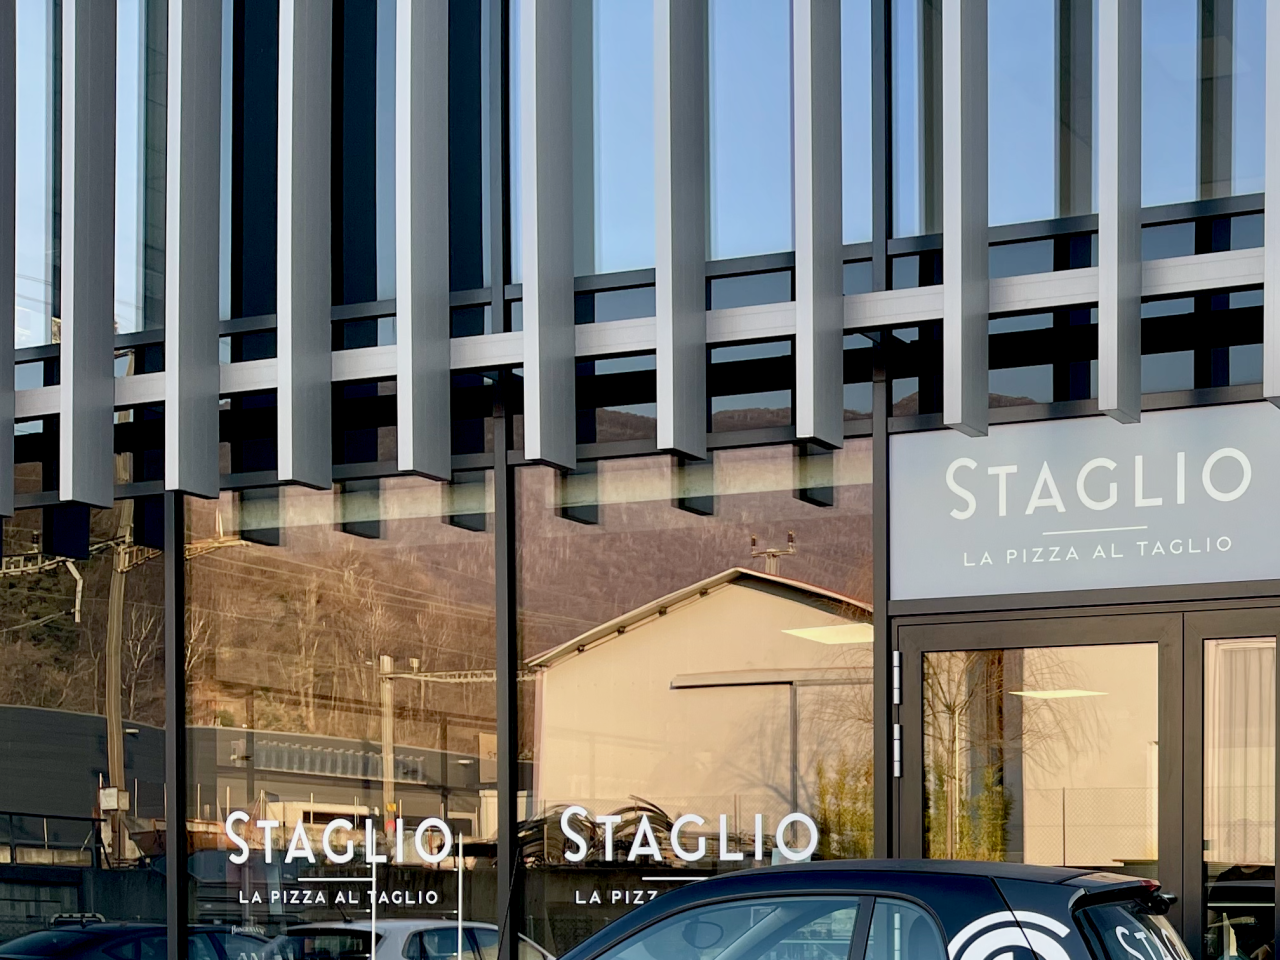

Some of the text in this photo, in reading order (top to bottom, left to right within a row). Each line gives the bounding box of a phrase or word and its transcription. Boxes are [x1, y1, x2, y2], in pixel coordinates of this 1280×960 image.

[945, 447, 1252, 520] STAGLIO
[963, 536, 1232, 567] LA PIZZA AL TAGLIO
[225, 810, 452, 865] STAGLIO
[560, 805, 819, 862] STAGLIO
[239, 890, 438, 905] LA PIZZA AL TAGLIO
[575, 890, 658, 905] LA PIZZ
